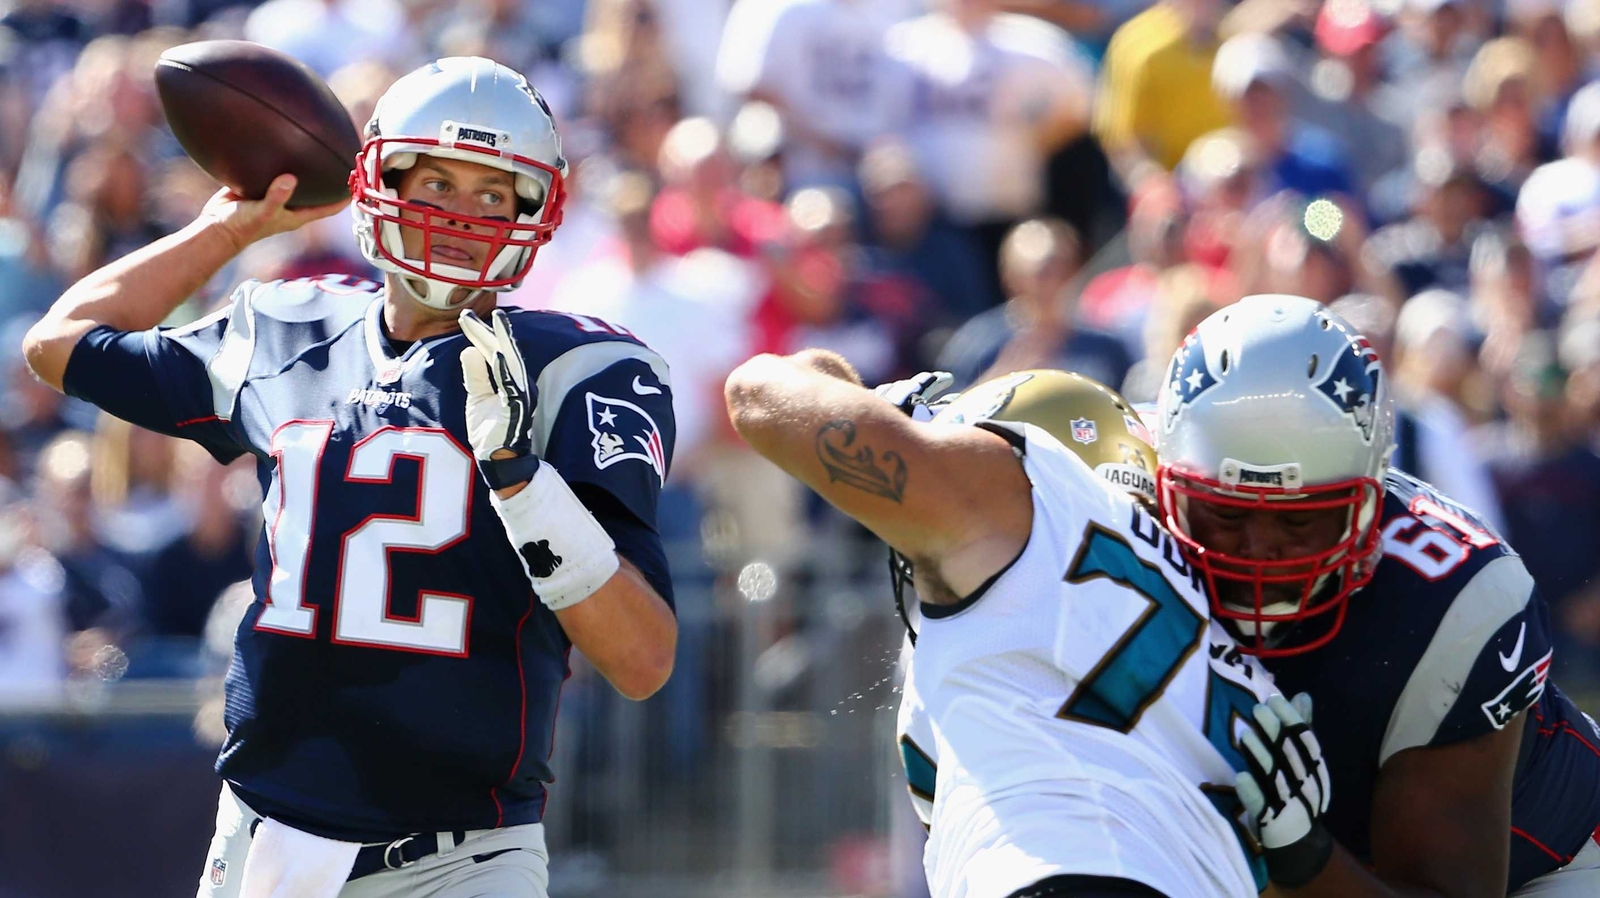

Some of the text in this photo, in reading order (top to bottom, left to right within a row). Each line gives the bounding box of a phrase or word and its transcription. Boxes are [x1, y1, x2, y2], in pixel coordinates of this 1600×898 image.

[457, 127, 497, 147] PATRIOTS
[345, 388, 412, 409] PATRIOTS
[1239, 468, 1283, 486] PATRIOTS
[254, 419, 475, 659] 12
[1379, 494, 1500, 583] 61
